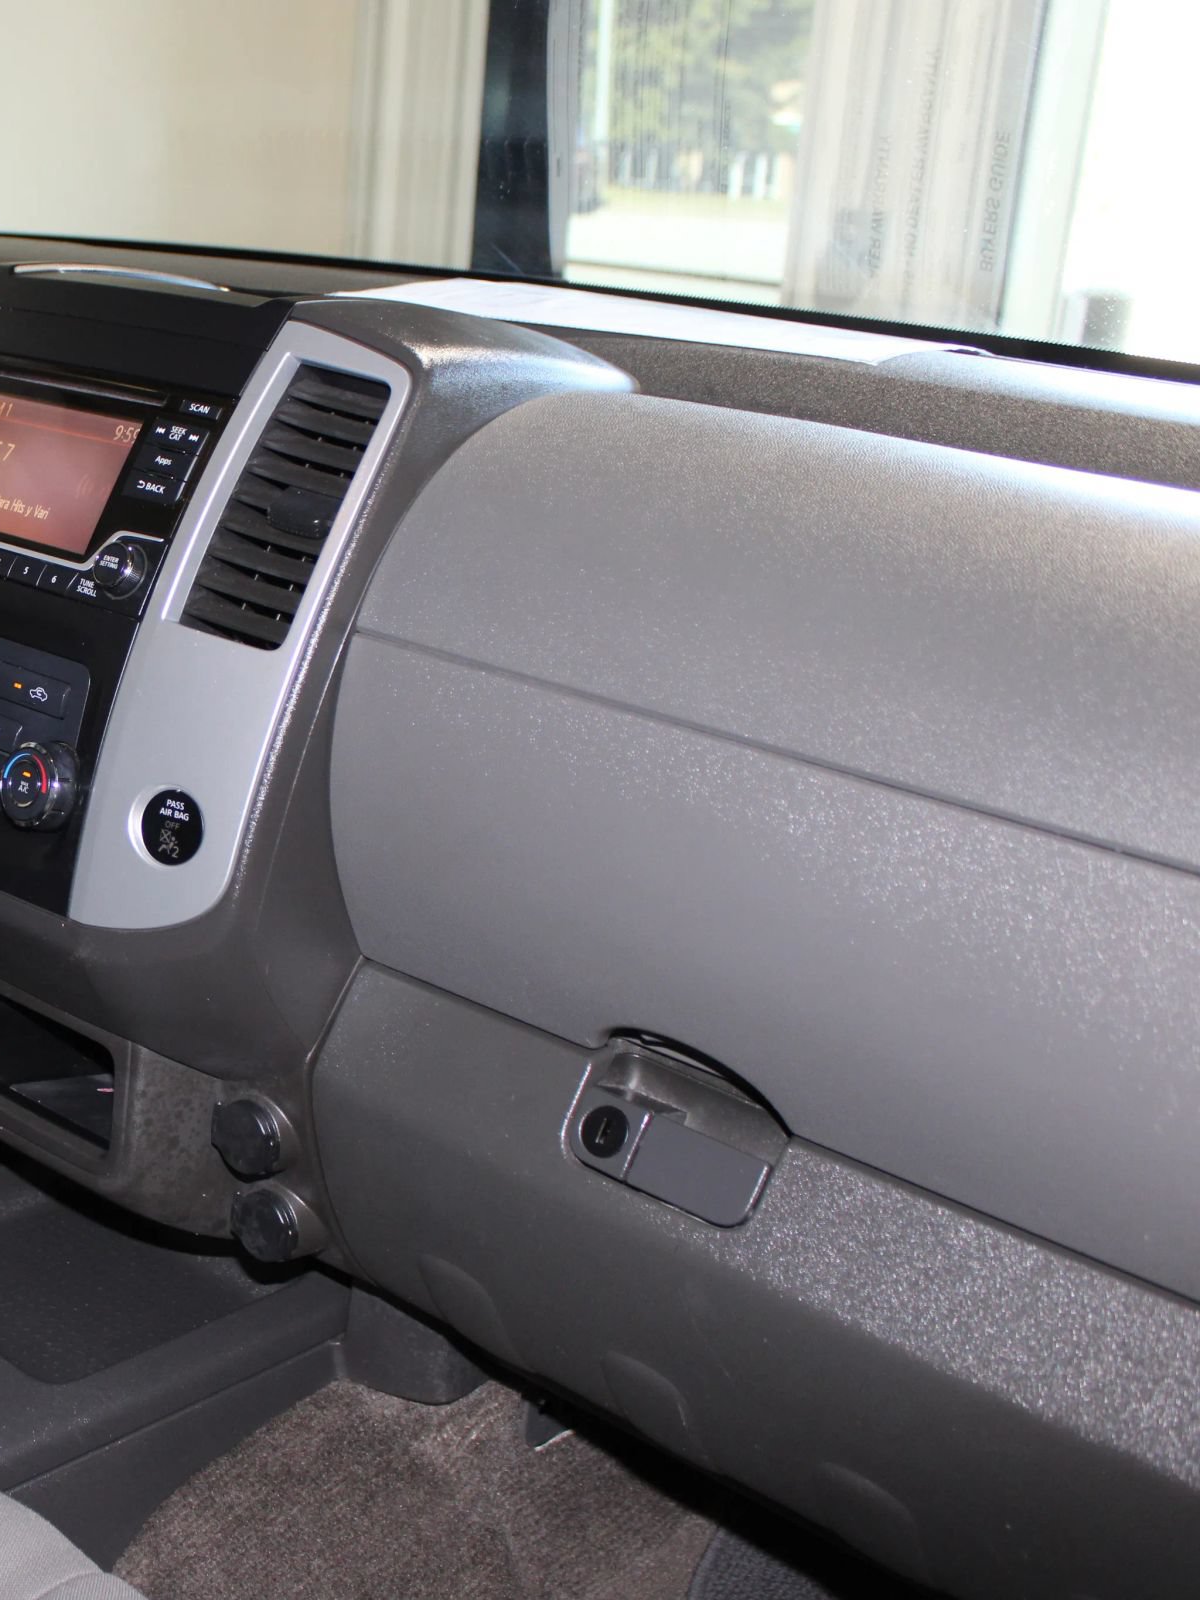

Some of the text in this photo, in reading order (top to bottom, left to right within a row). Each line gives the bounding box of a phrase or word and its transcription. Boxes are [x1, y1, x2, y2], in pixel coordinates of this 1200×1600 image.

[189, 404, 210, 414] SCAN
[169, 432, 182, 440] CAT
[170, 426, 188, 436] SEEK
[155, 456, 172, 466] Apps
[145, 482, 166, 494] BACK
[10, 498, 26, 514] Hits
[24, 505, 33, 517] y
[104, 554, 119, 563] ENTER
[23, 566, 29, 574] 5
[100, 560, 118, 570] SETTING
[80, 578, 94, 587] TUNE
[76, 586, 96, 597] SCROLL
[166, 799, 184, 810] PASS
[160, 808, 190, 821] AIR BAG
[165, 820, 180, 830] OFF
